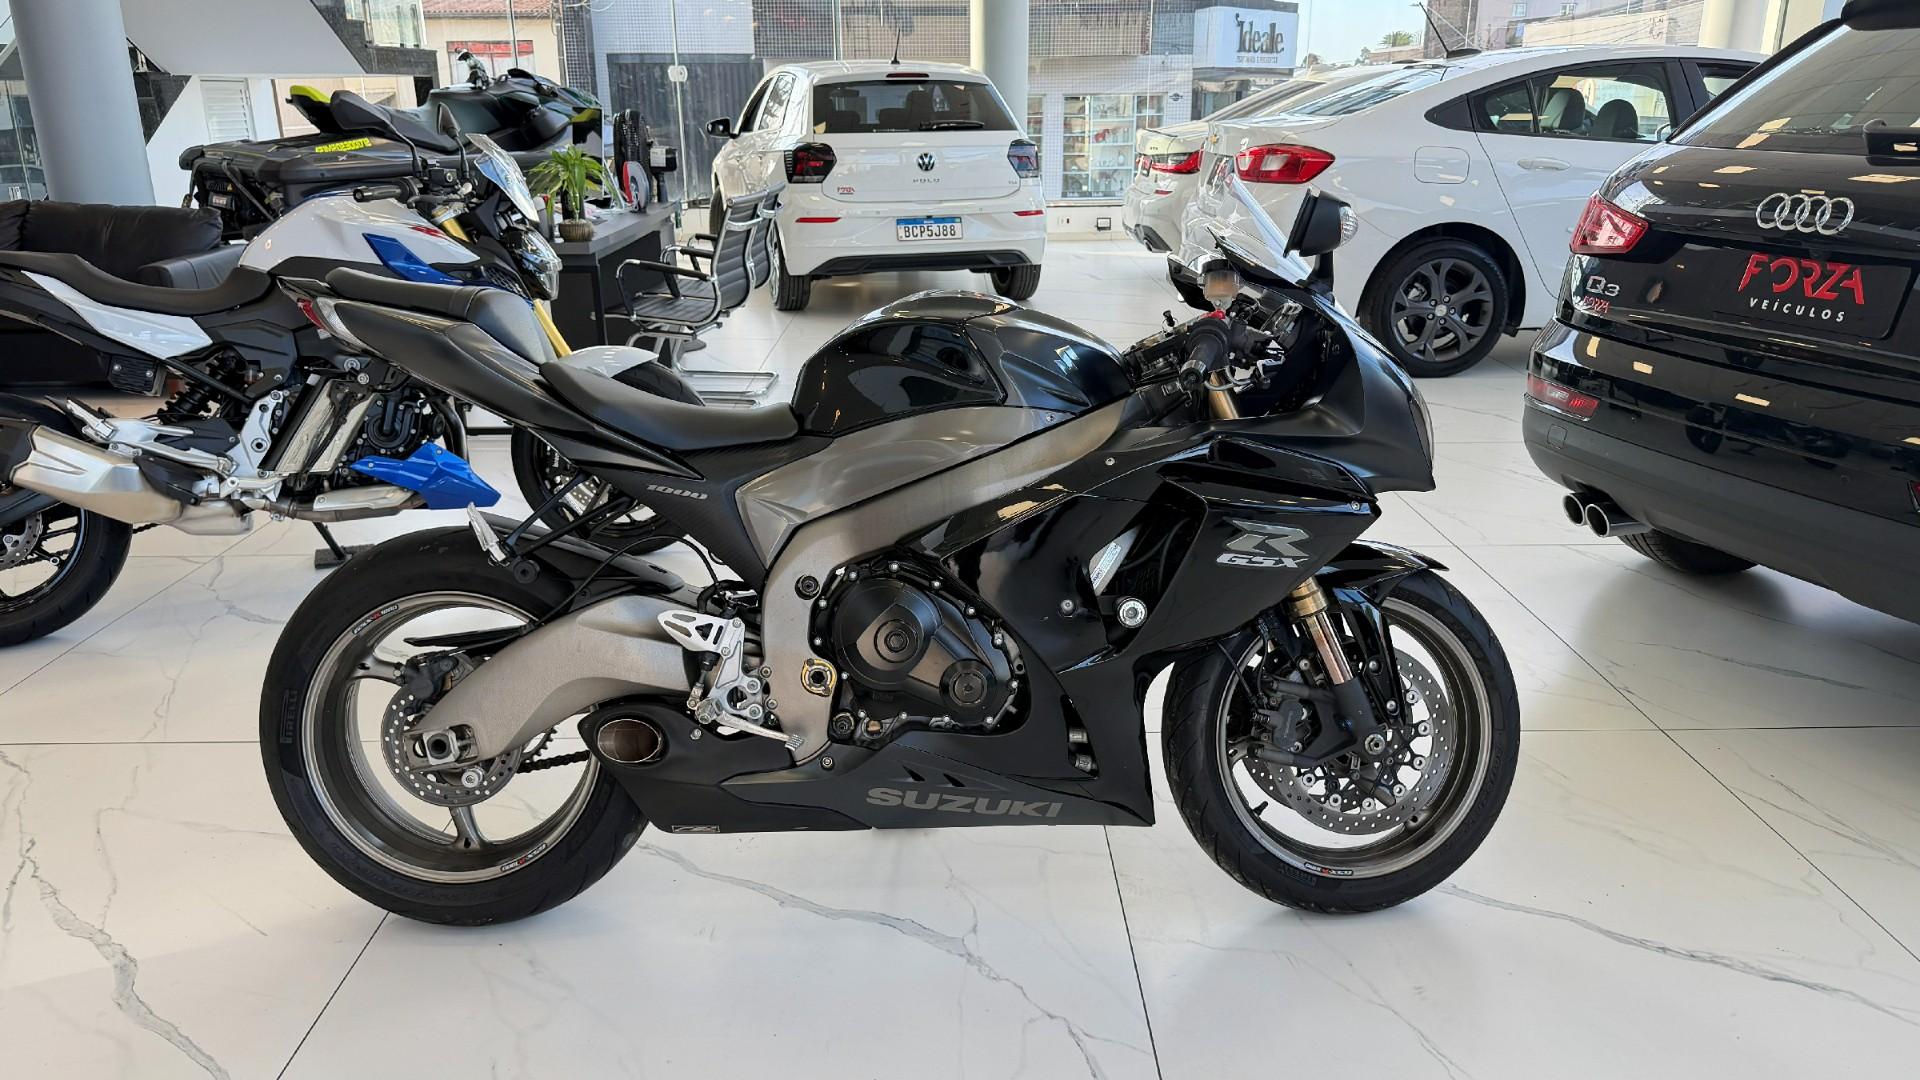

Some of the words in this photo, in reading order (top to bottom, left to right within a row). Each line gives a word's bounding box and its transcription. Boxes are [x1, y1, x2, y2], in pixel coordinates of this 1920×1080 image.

[903, 225, 957, 239] BCP5J88
[1585, 275, 1620, 297] Q3
[1737, 253, 1866, 306] FORZA
[1749, 297, 1846, 323] VEÍCULOS
[646, 484, 708, 500] 1000
[1215, 552, 1310, 569] GSX
[866, 787, 1065, 818] SUZUKI
